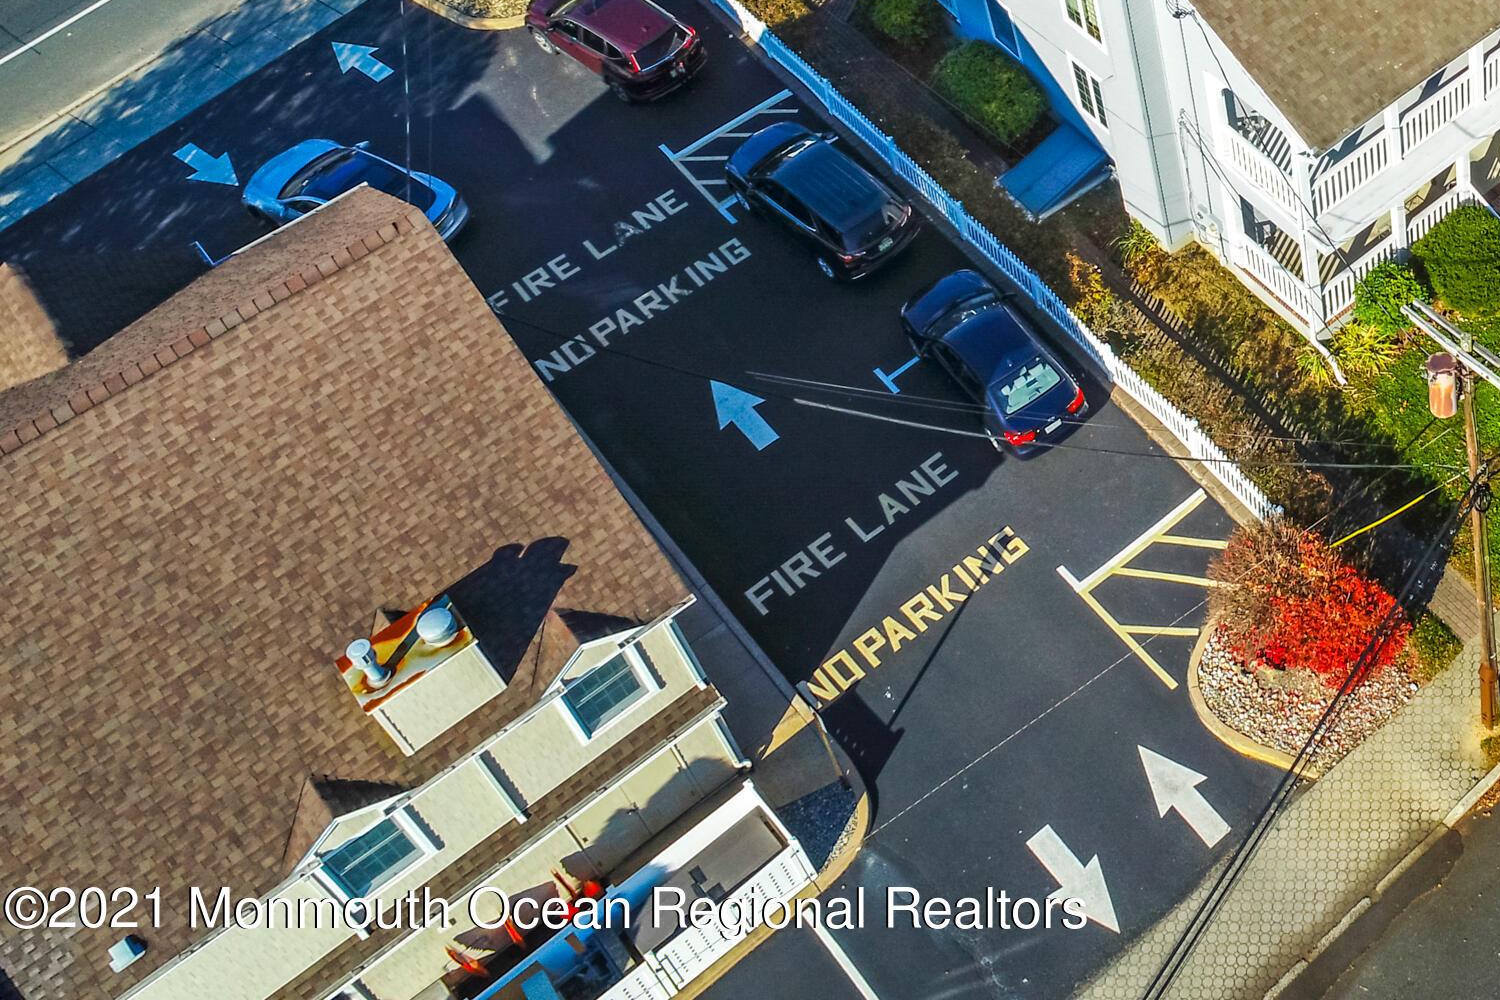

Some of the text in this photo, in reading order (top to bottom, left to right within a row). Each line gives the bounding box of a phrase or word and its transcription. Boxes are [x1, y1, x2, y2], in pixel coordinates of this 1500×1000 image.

[487, 188, 689, 315] FIRE LANE
[534, 237, 752, 382] NO PARKING
[743, 451, 960, 616] FIRE LANE
[802, 525, 1031, 711] NO PARKING
